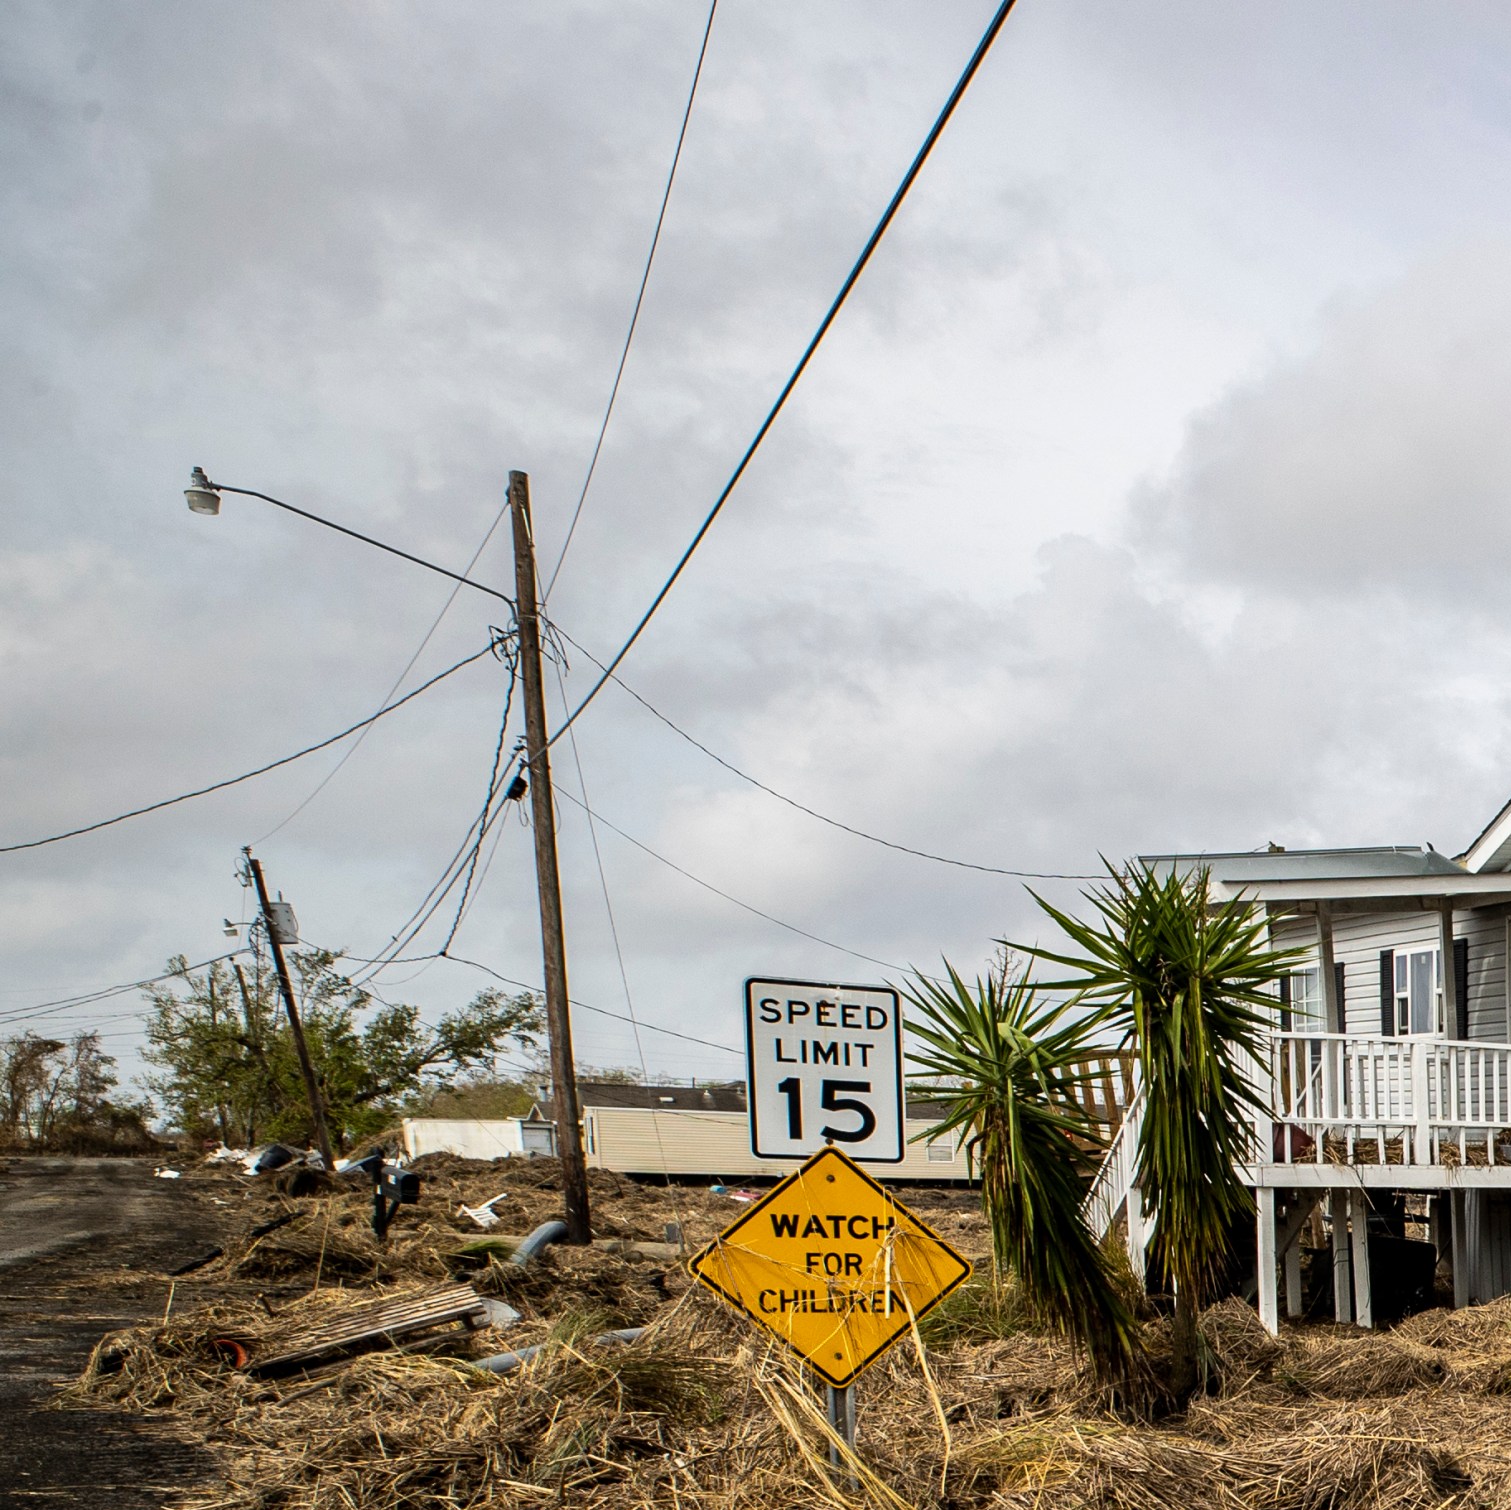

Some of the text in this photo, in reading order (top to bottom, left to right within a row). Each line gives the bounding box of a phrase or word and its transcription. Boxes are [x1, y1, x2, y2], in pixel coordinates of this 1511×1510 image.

[759, 997, 889, 1031] SPEED
[775, 1038, 875, 1068] LIMIT
[777, 1077, 877, 1144] 15
[769, 1213, 896, 1239] WATCH
[805, 1253, 863, 1276] FOR
[758, 1289, 909, 1314] CHILDREN
